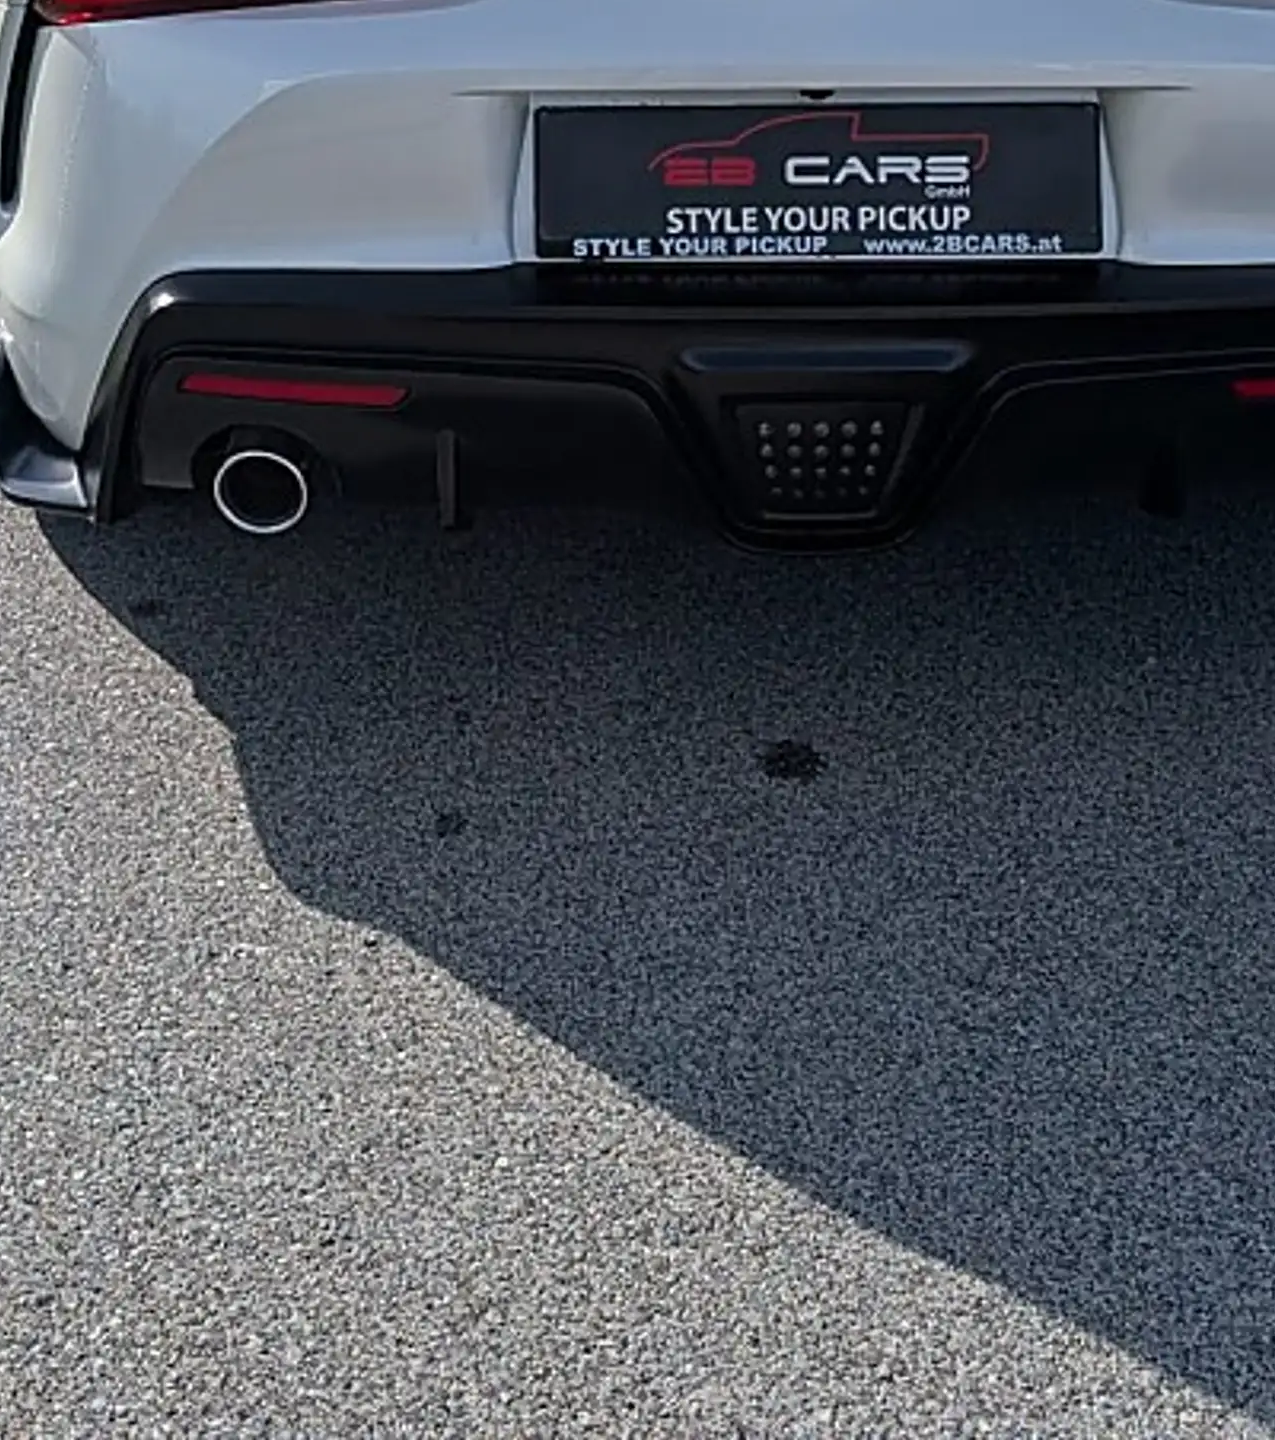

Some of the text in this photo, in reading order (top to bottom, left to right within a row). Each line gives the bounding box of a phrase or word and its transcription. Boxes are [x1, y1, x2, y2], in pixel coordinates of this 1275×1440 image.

[664, 156, 970, 186] 2B CARS
[925, 185, 971, 198] GmbH
[666, 206, 971, 234] STYLE YOUR PICKUP
[573, 233, 1062, 256] STYLE YOUR PICKUP www.2BCARS.at
